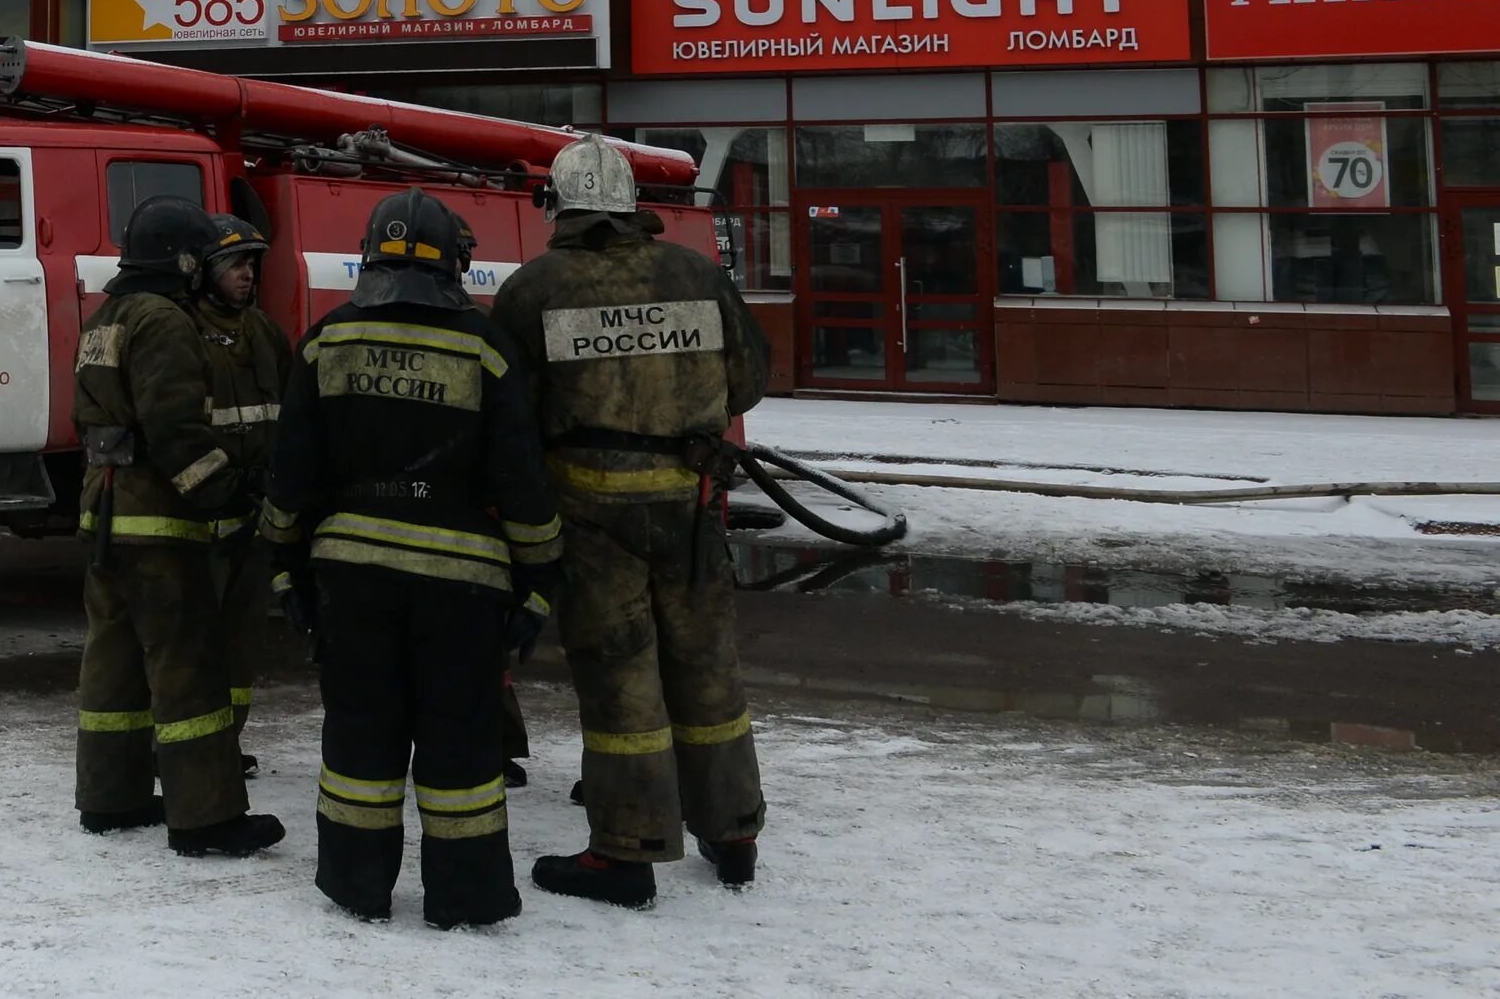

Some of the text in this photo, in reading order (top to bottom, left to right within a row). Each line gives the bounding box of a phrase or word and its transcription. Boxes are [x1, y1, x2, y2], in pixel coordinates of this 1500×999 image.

[173, 27, 265, 41] ювелирная сеть
[294, 18, 573, 37] ЮВЕЛИРНЫЙ МАГАЗИН ЛОМБАРД
[672, 27, 1139, 60] ЮВЕЛИРНЫЙ МАГАЗИН ЛОМБАРД
[584, 172, 596, 190] 3
[393, 224, 401, 236] 3
[600, 306, 666, 328] МЧС
[572, 329, 702, 356] РОССИИ
[365, 348, 426, 371] МЧС
[346, 372, 448, 402] РОССИИ
